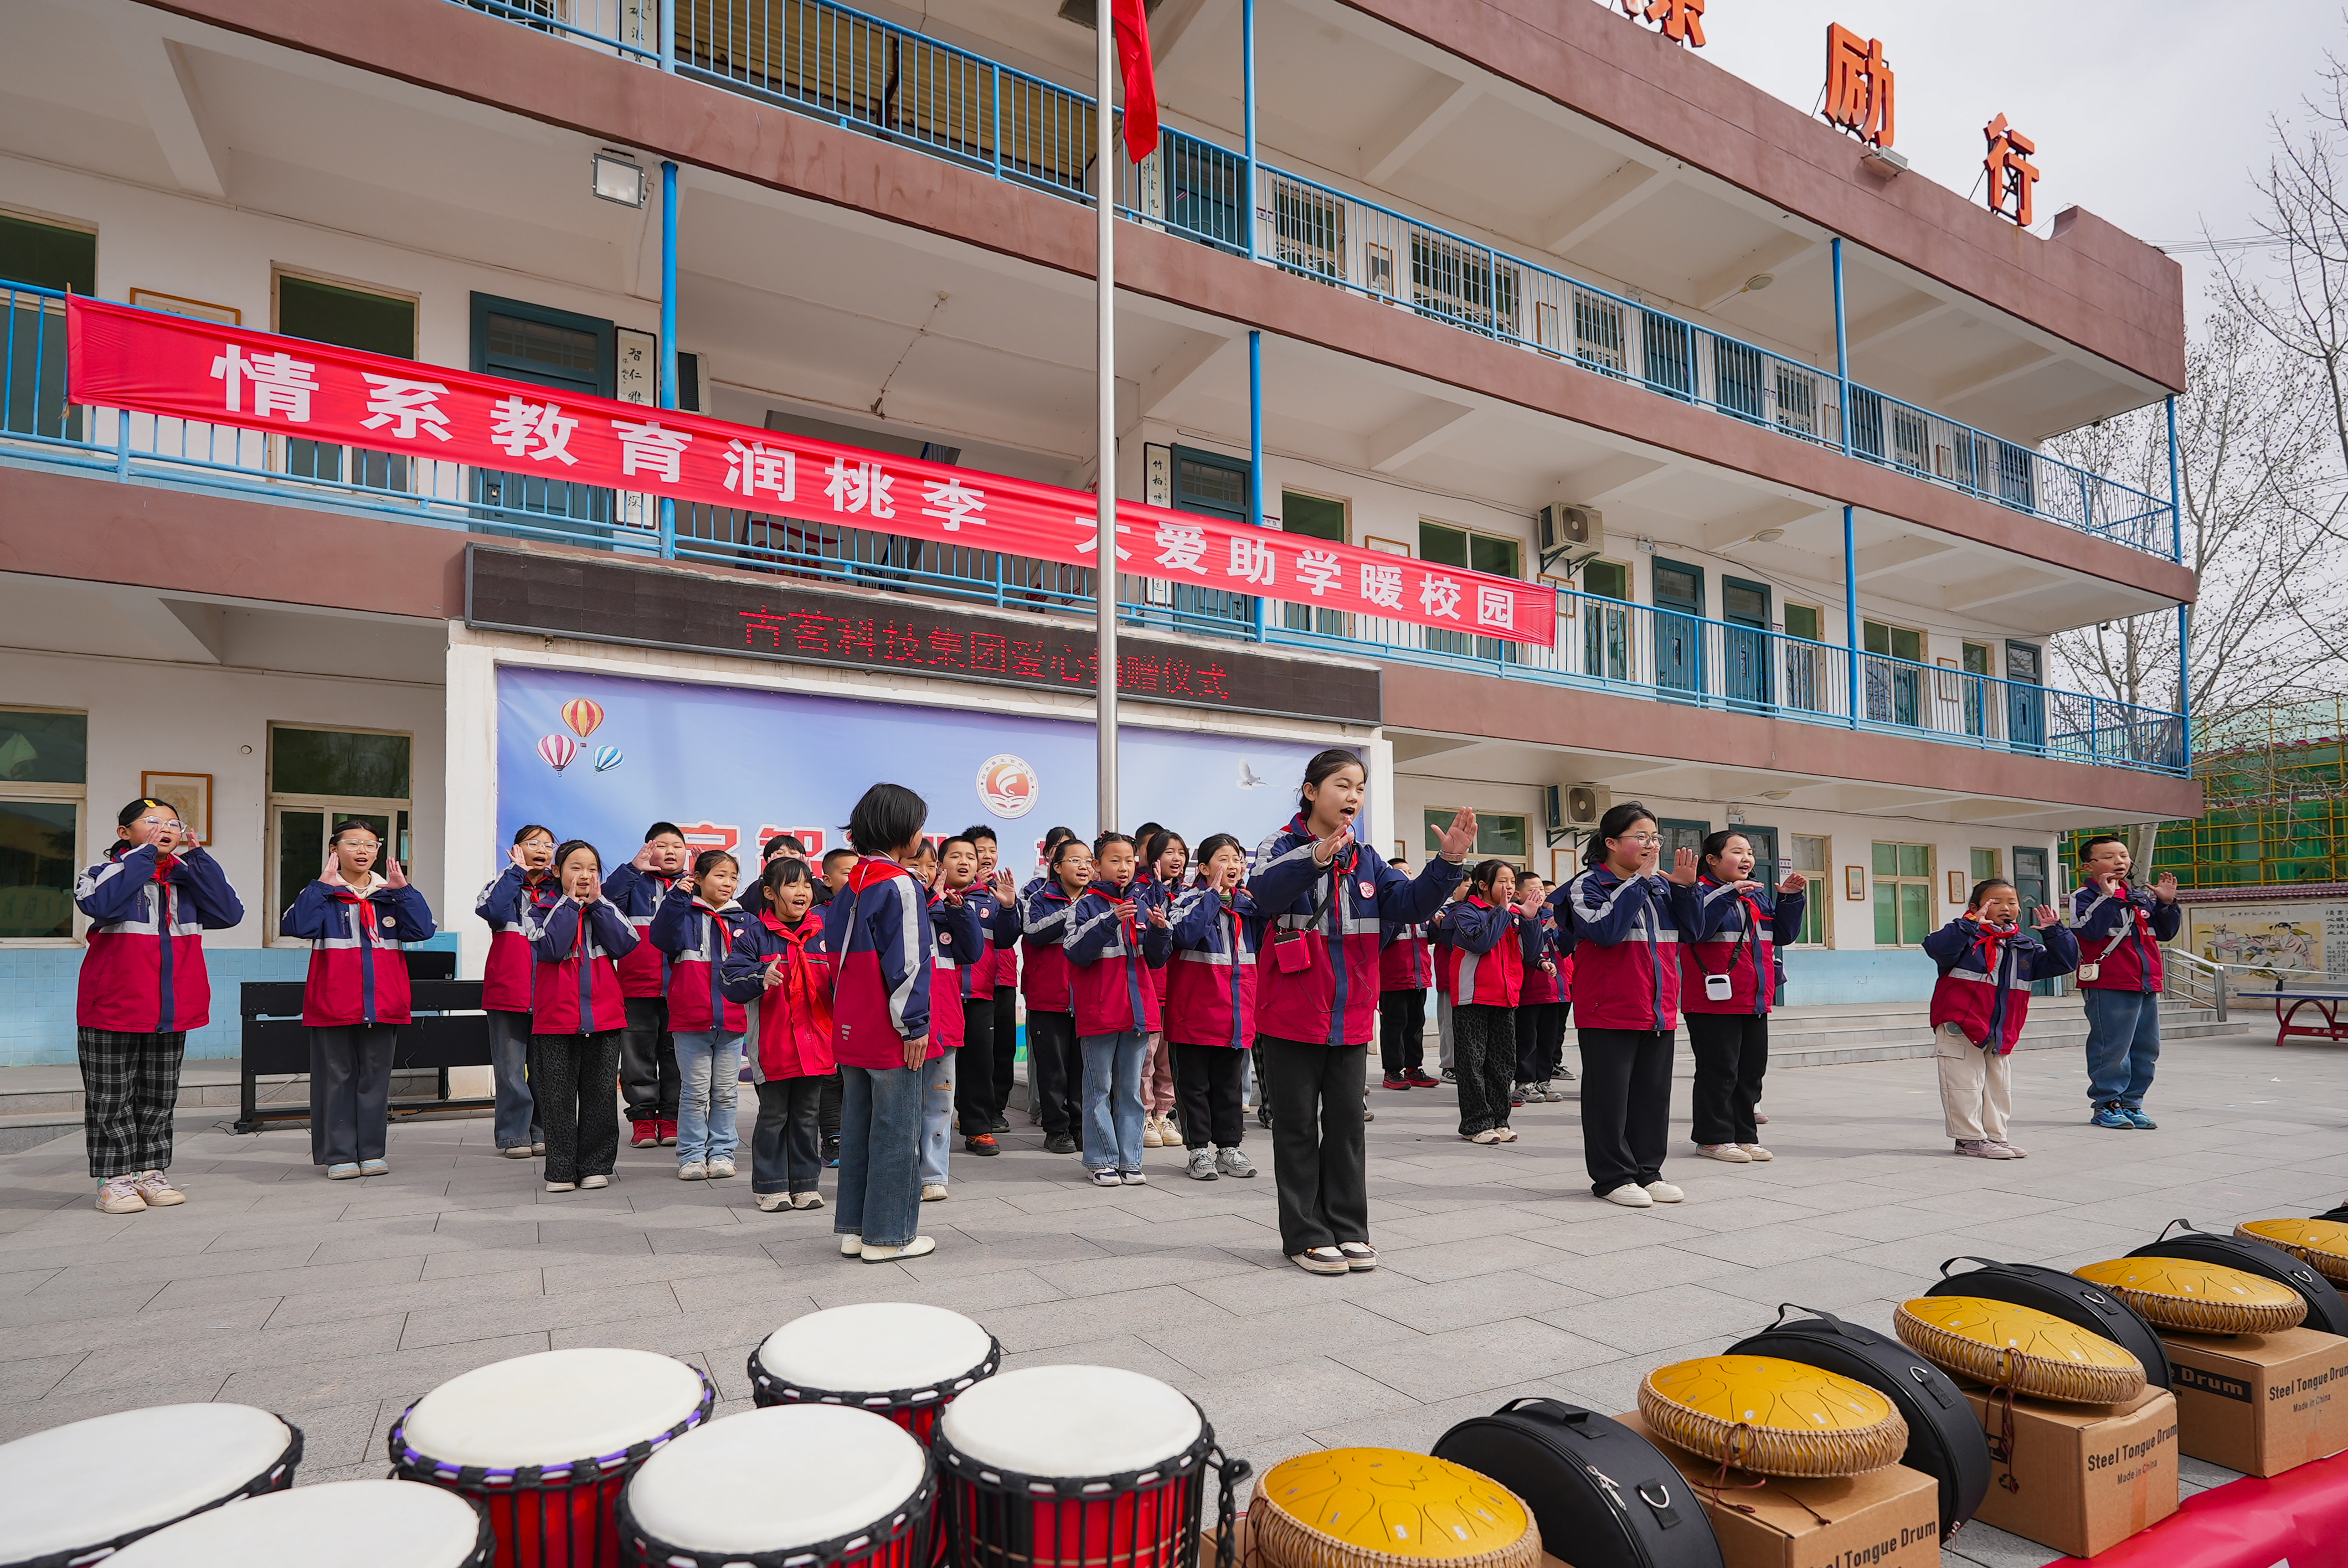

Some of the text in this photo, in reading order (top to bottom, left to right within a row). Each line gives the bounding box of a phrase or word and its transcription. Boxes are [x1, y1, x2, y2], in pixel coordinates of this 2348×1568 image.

[210, 344, 1514, 631] 情系教育润桃李 大爱助学暖校园
[2181, 1368, 2243, 1396] Drum
[2269, 1365, 2348, 1401] Steel Tongue Drum
[2293, 1394, 2331, 1412] Made in China
[2087, 1423, 2177, 1472] Steel Tongue Drum
[2117, 1459, 2158, 1485] Made in China
[1844, 1536, 1897, 1568] Tongue
[1901, 1520, 1936, 1548] Drum
